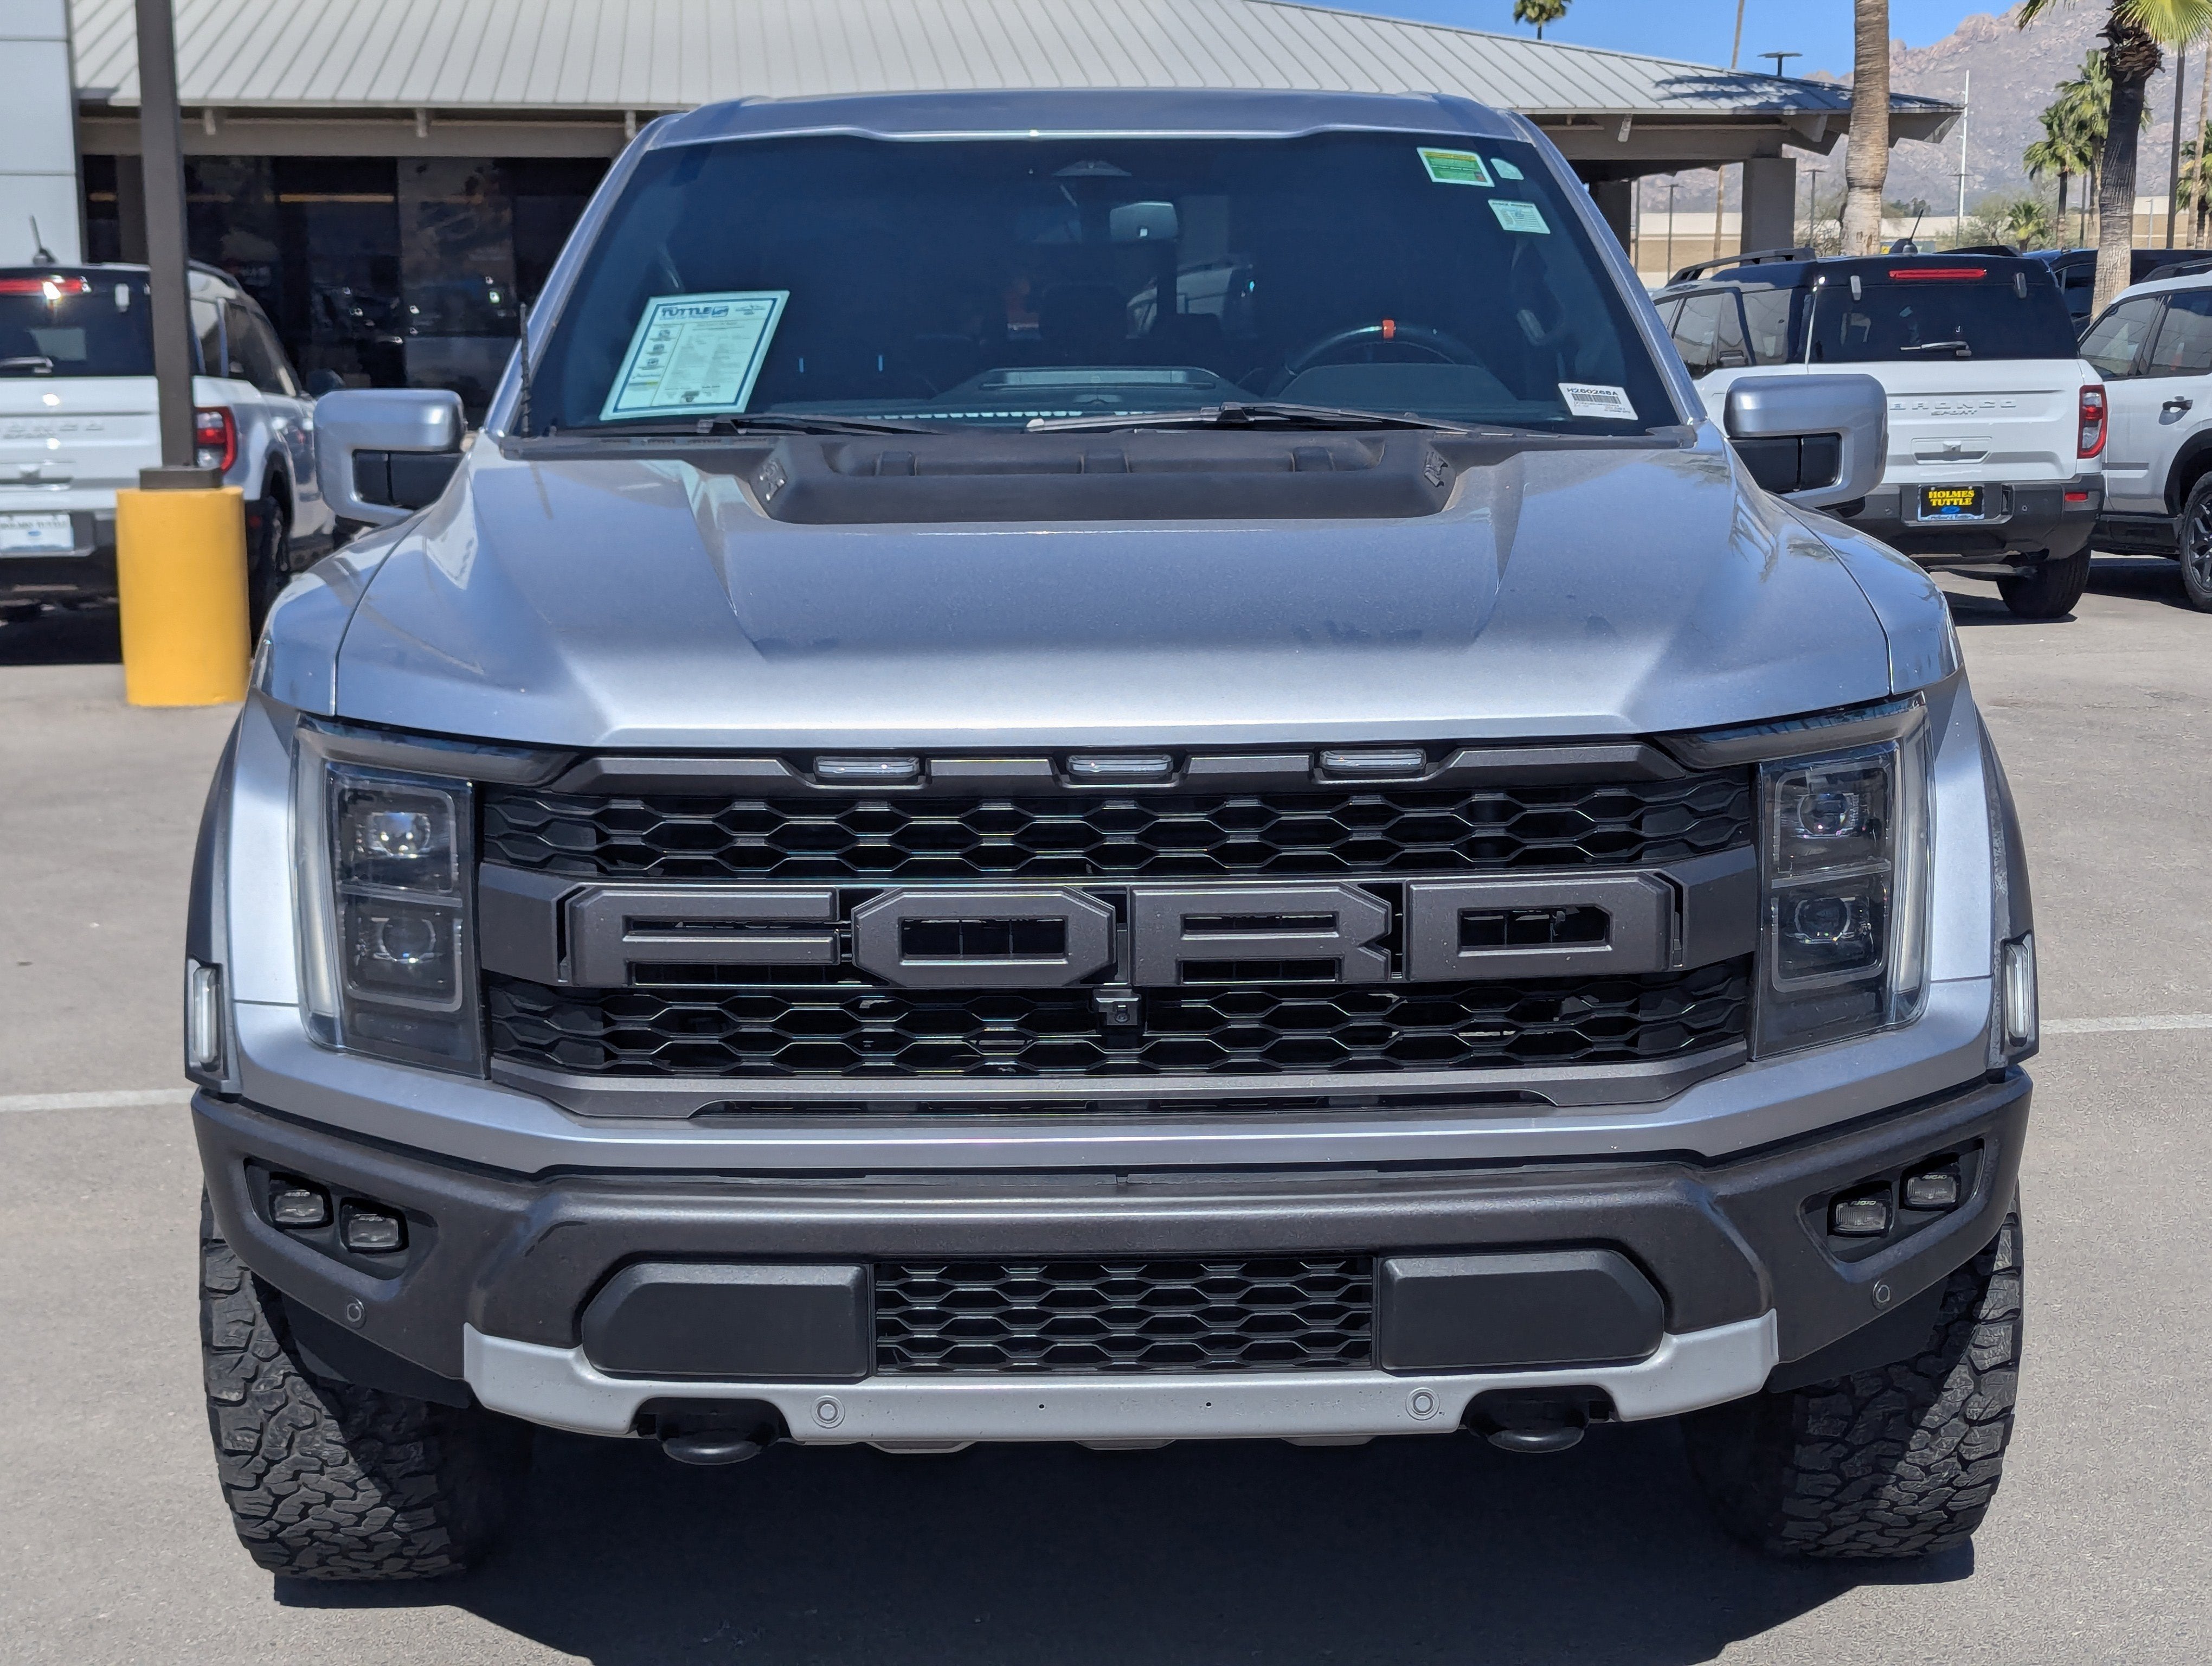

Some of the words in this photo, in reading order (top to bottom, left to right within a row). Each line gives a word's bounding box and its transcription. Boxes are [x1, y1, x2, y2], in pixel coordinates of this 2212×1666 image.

[1888, 399, 2017, 411] BRONCO
[1928, 490, 1975, 498] HOLMES
[1930, 498, 1972, 506] TUTTLE
[571, 876, 1671, 988] FORD
